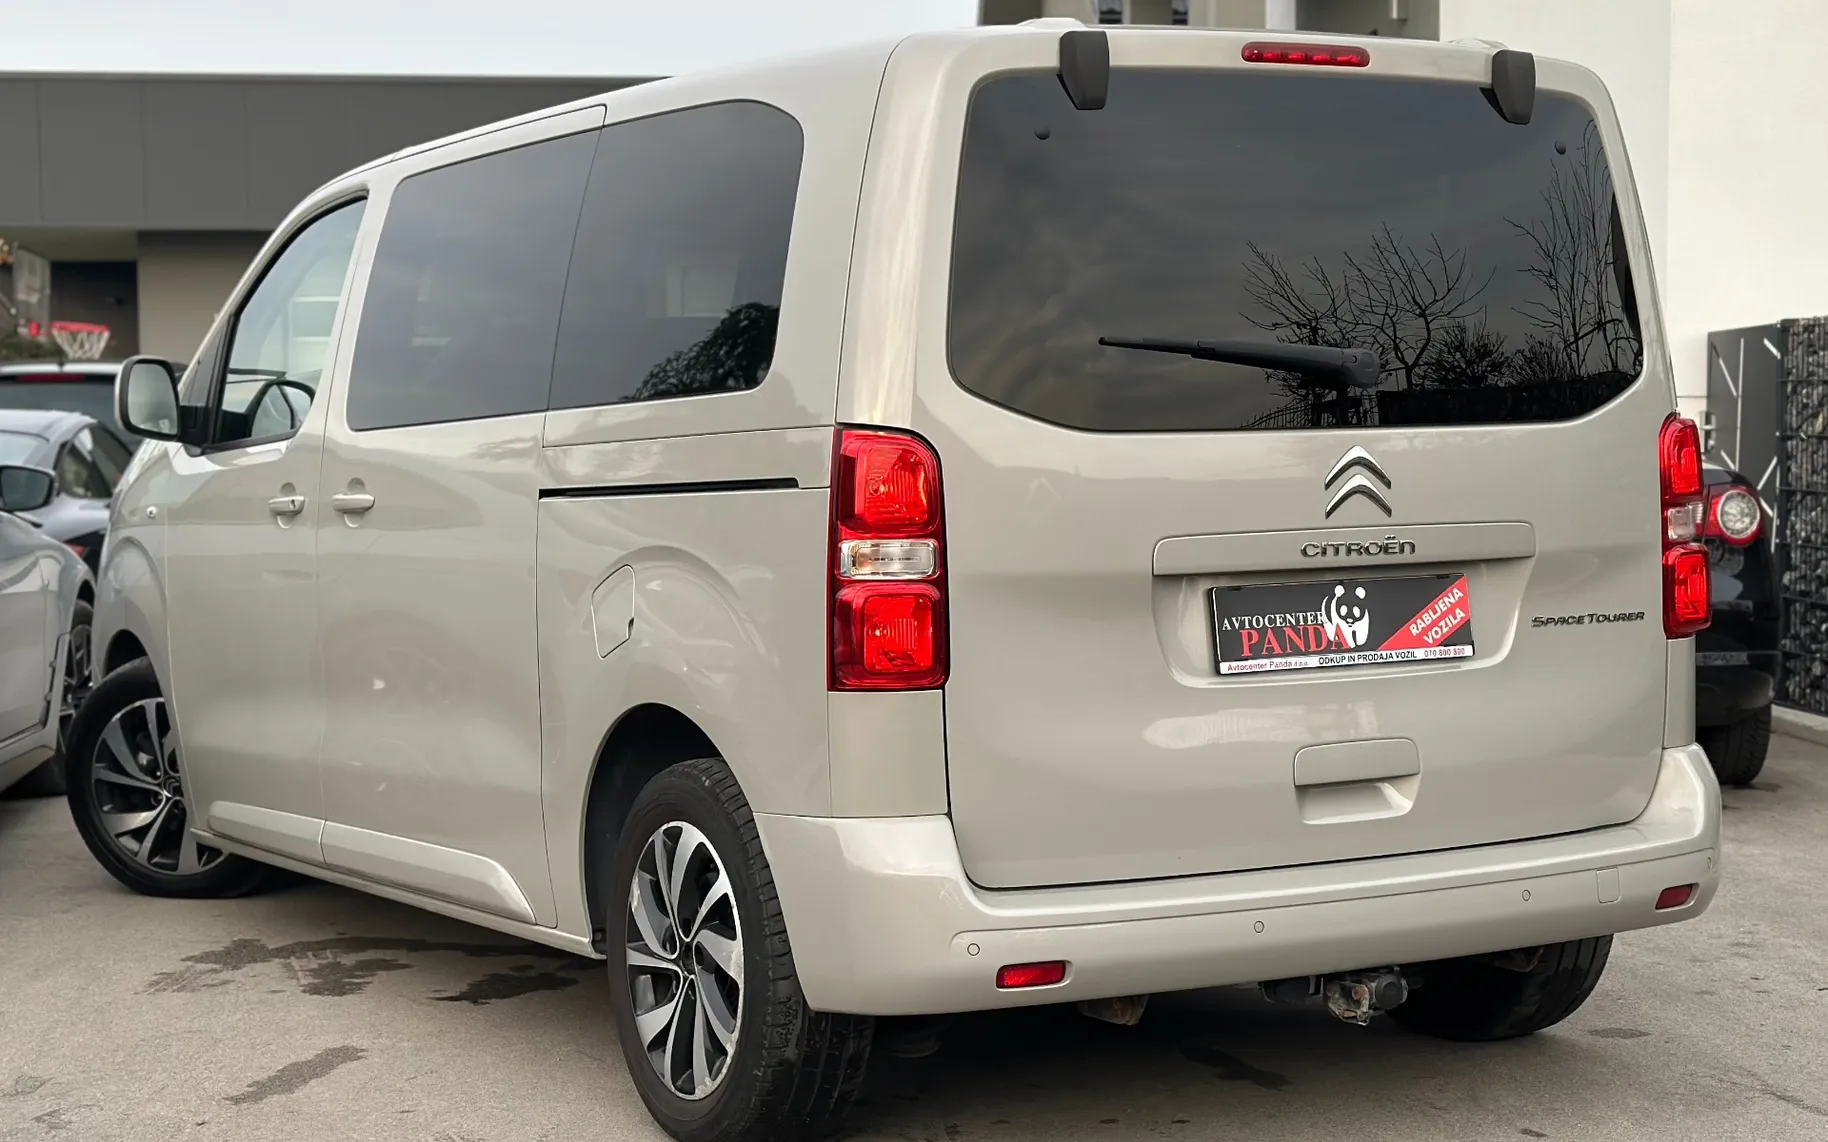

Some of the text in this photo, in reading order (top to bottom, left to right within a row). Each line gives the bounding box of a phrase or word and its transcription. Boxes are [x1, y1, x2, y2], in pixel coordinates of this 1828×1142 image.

[1222, 611, 1327, 631] AVTOCENTER
[1409, 588, 1464, 636] RABLJENA
[1240, 622, 1351, 657] PANDA
[1423, 608, 1465, 644] VOZILA
[1227, 662, 1267, 672] Avtocenter
[1269, 660, 1292, 669] Panda
[1318, 655, 1346, 665] ODKUP
[1347, 655, 1356, 664] IN
[1357, 653, 1394, 662] PRODAJA
[1394, 651, 1418, 660] VOZIL
